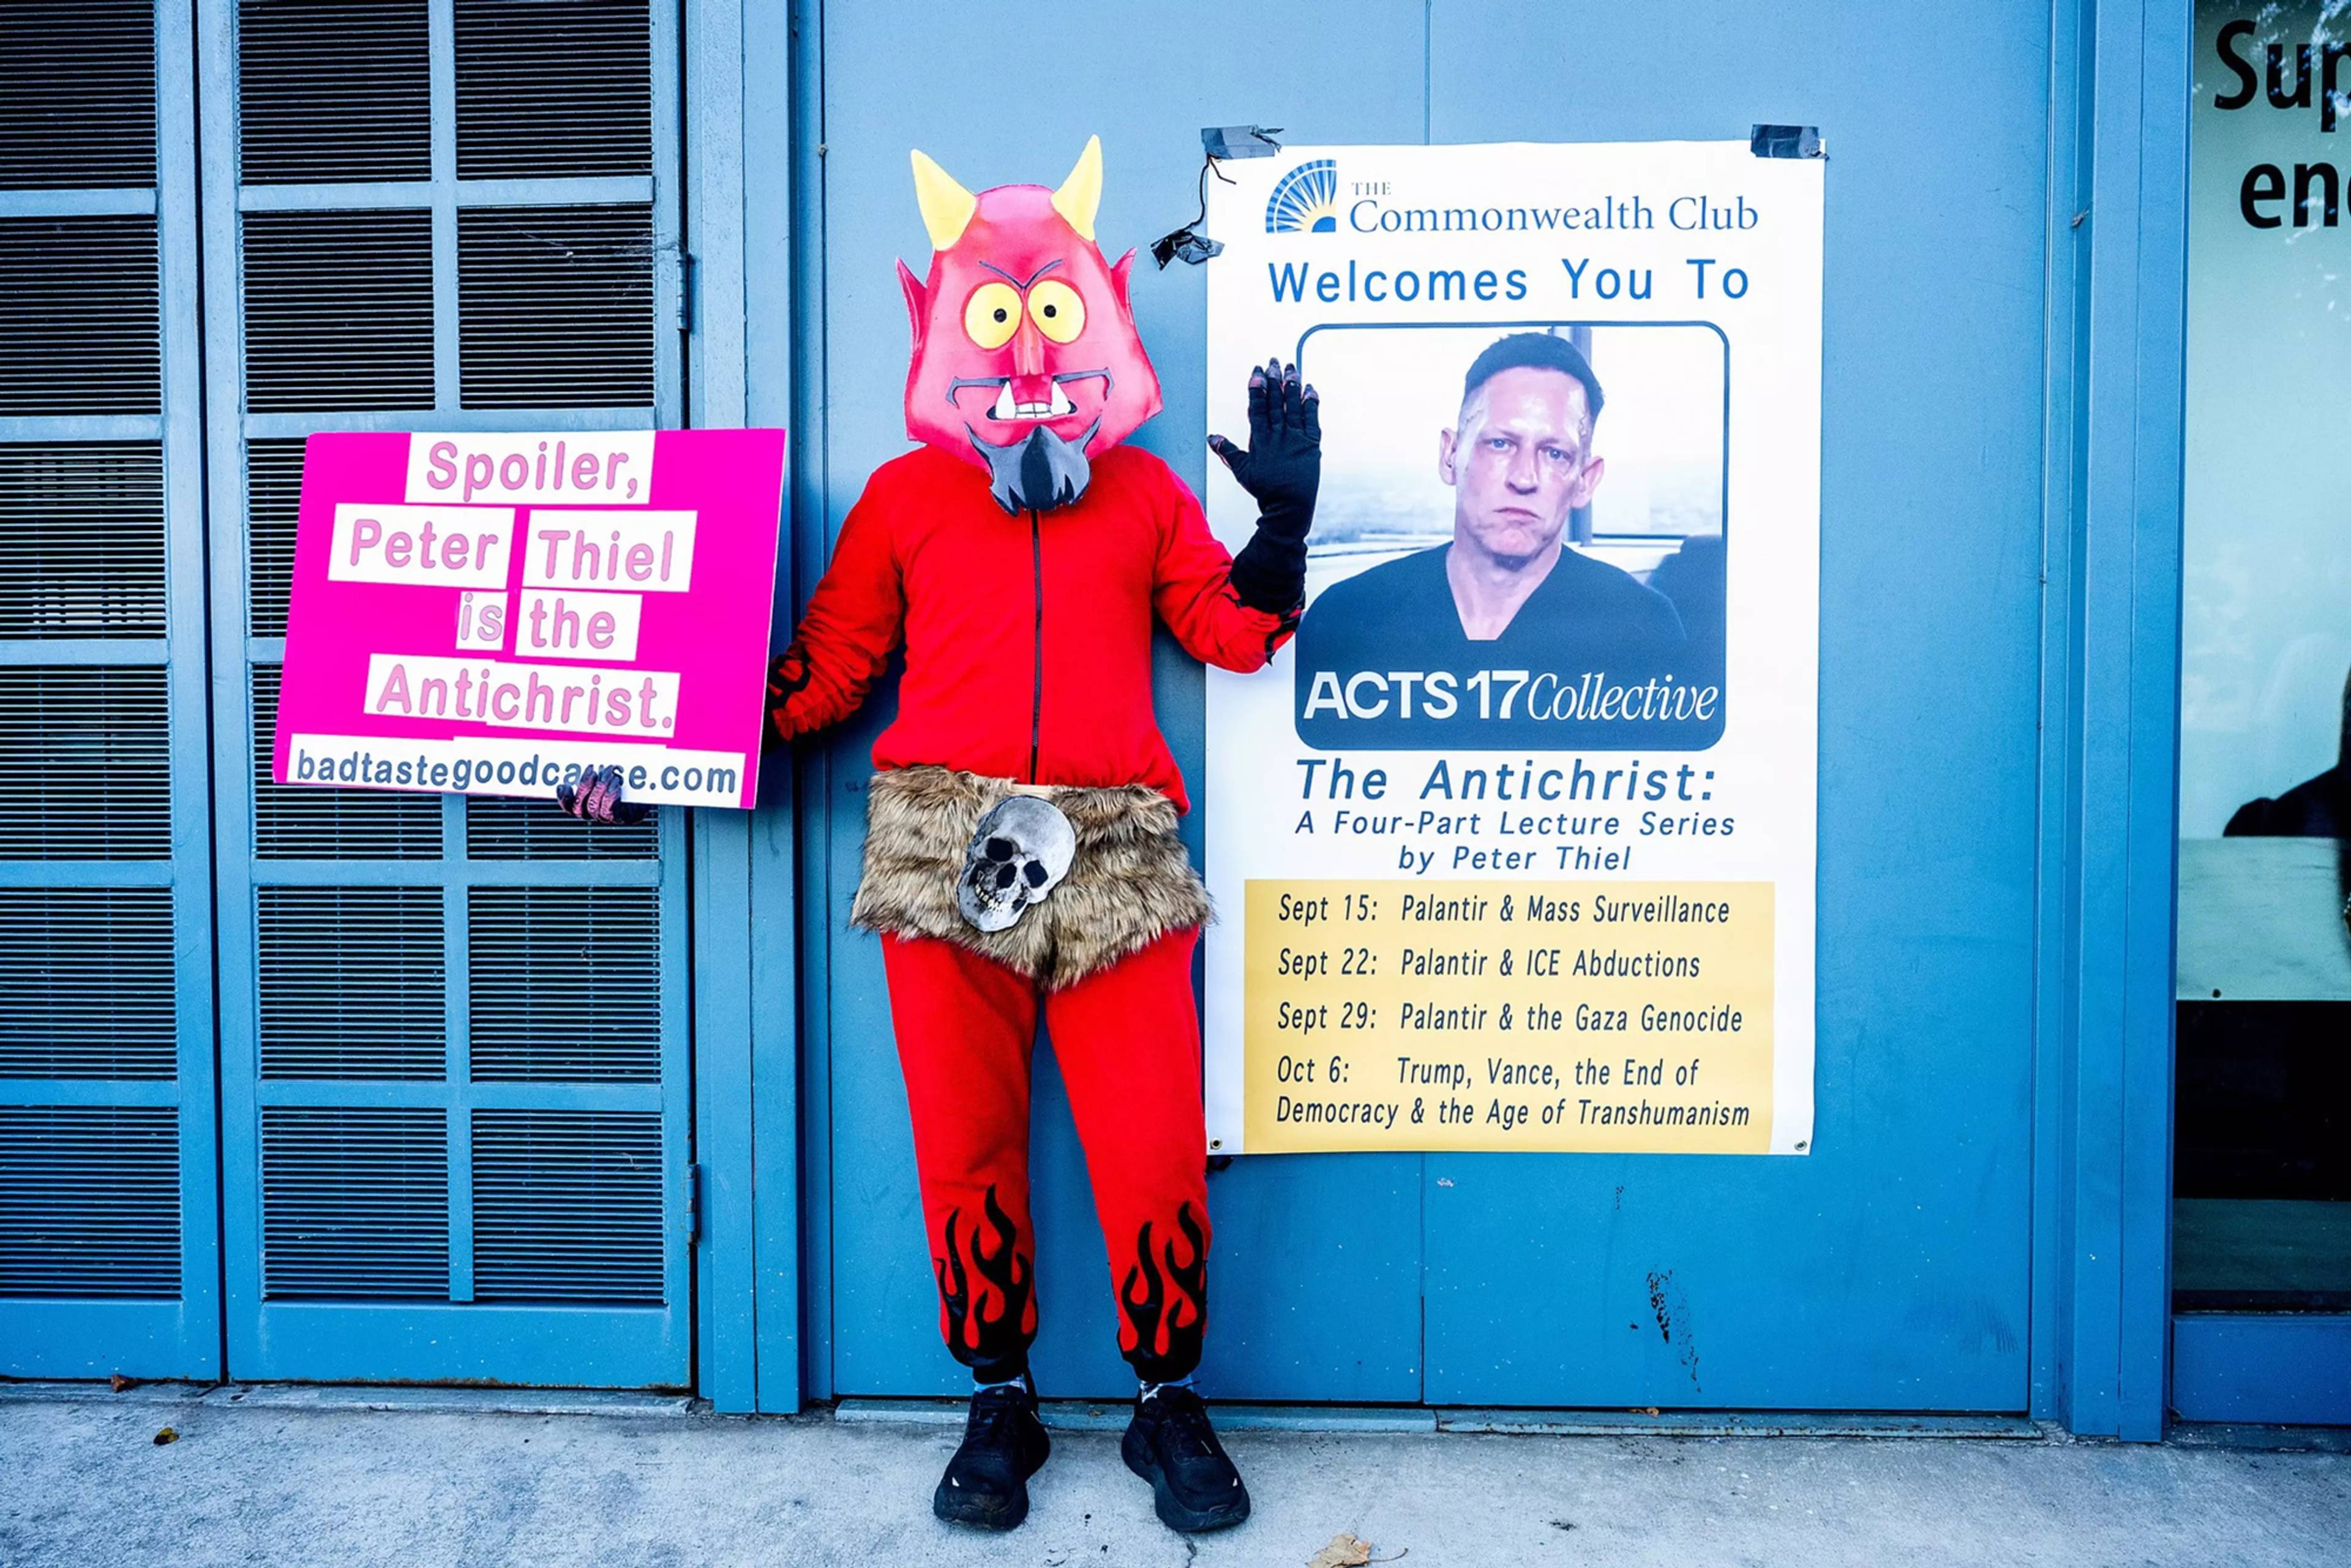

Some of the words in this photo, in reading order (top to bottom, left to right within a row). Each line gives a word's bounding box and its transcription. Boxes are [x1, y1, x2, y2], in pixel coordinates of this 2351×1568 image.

[1351, 182, 1392, 195] THE
[2240, 162, 2351, 229] en
[1350, 196, 1653, 232] Commonwealth
[1670, 196, 1758, 230] Club
[1269, 260, 1526, 302] Welcomes
[1562, 259, 1651, 299] You
[1687, 260, 1747, 299] To
[426, 440, 638, 503] Spoiler,
[350, 518, 499, 571] Peter
[538, 530, 674, 582] Thiel
[460, 593, 504, 642] is
[530, 598, 617, 649] the
[376, 664, 673, 729] Antichrist.
[1297, 758, 1386, 800] The
[1420, 759, 1714, 801] Antichrist:
[1295, 811, 1313, 833] A
[1335, 811, 1480, 835] Four-Part
[1500, 811, 1619, 835] Lecture
[1640, 811, 1734, 835] Series
[1399, 846, 1434, 874] by
[1453, 846, 1536, 869] Peter
[1557, 846, 1630, 870] Thiel
[1279, 894, 1328, 926] Sept
[1345, 895, 1377, 921] 15:
[1402, 894, 1487, 921] Palantir
[1501, 895, 1513, 921] &
[1528, 896, 1580, 921] Mass
[1594, 895, 1728, 922] Surveillance
[1278, 948, 1327, 981] Sept
[1342, 948, 1376, 975] 22:
[1401, 948, 1487, 975] Palantir
[1500, 949, 1513, 976] &
[1527, 949, 1560, 976] ICE
[1573, 949, 1699, 977] Abductions
[1278, 1002, 1327, 1035] Sept
[1341, 1002, 1376, 1029] 29:
[1401, 1002, 1487, 1030] Palantir
[1499, 1003, 1512, 1030] &
[1528, 1003, 1561, 1030] the
[1577, 1004, 1627, 1030] Gaza
[1642, 1004, 1741, 1031] Genocide
[1278, 1056, 1314, 1082] Oct
[1330, 1056, 1348, 1082] 6:
[1398, 1057, 1471, 1090] Trump,
[1488, 1058, 1559, 1089] Vance,
[1576, 1058, 1609, 1084] the
[1624, 1059, 1663, 1085] End
[1676, 1059, 1699, 1086] of
[1277, 1096, 1398, 1129] Democracy
[1411, 1098, 1424, 1123] &
[1440, 1097, 1473, 1123] the
[1486, 1099, 1528, 1130] Age
[1542, 1098, 1565, 1123] of
[1579, 1100, 1749, 1125] Transhumanism
